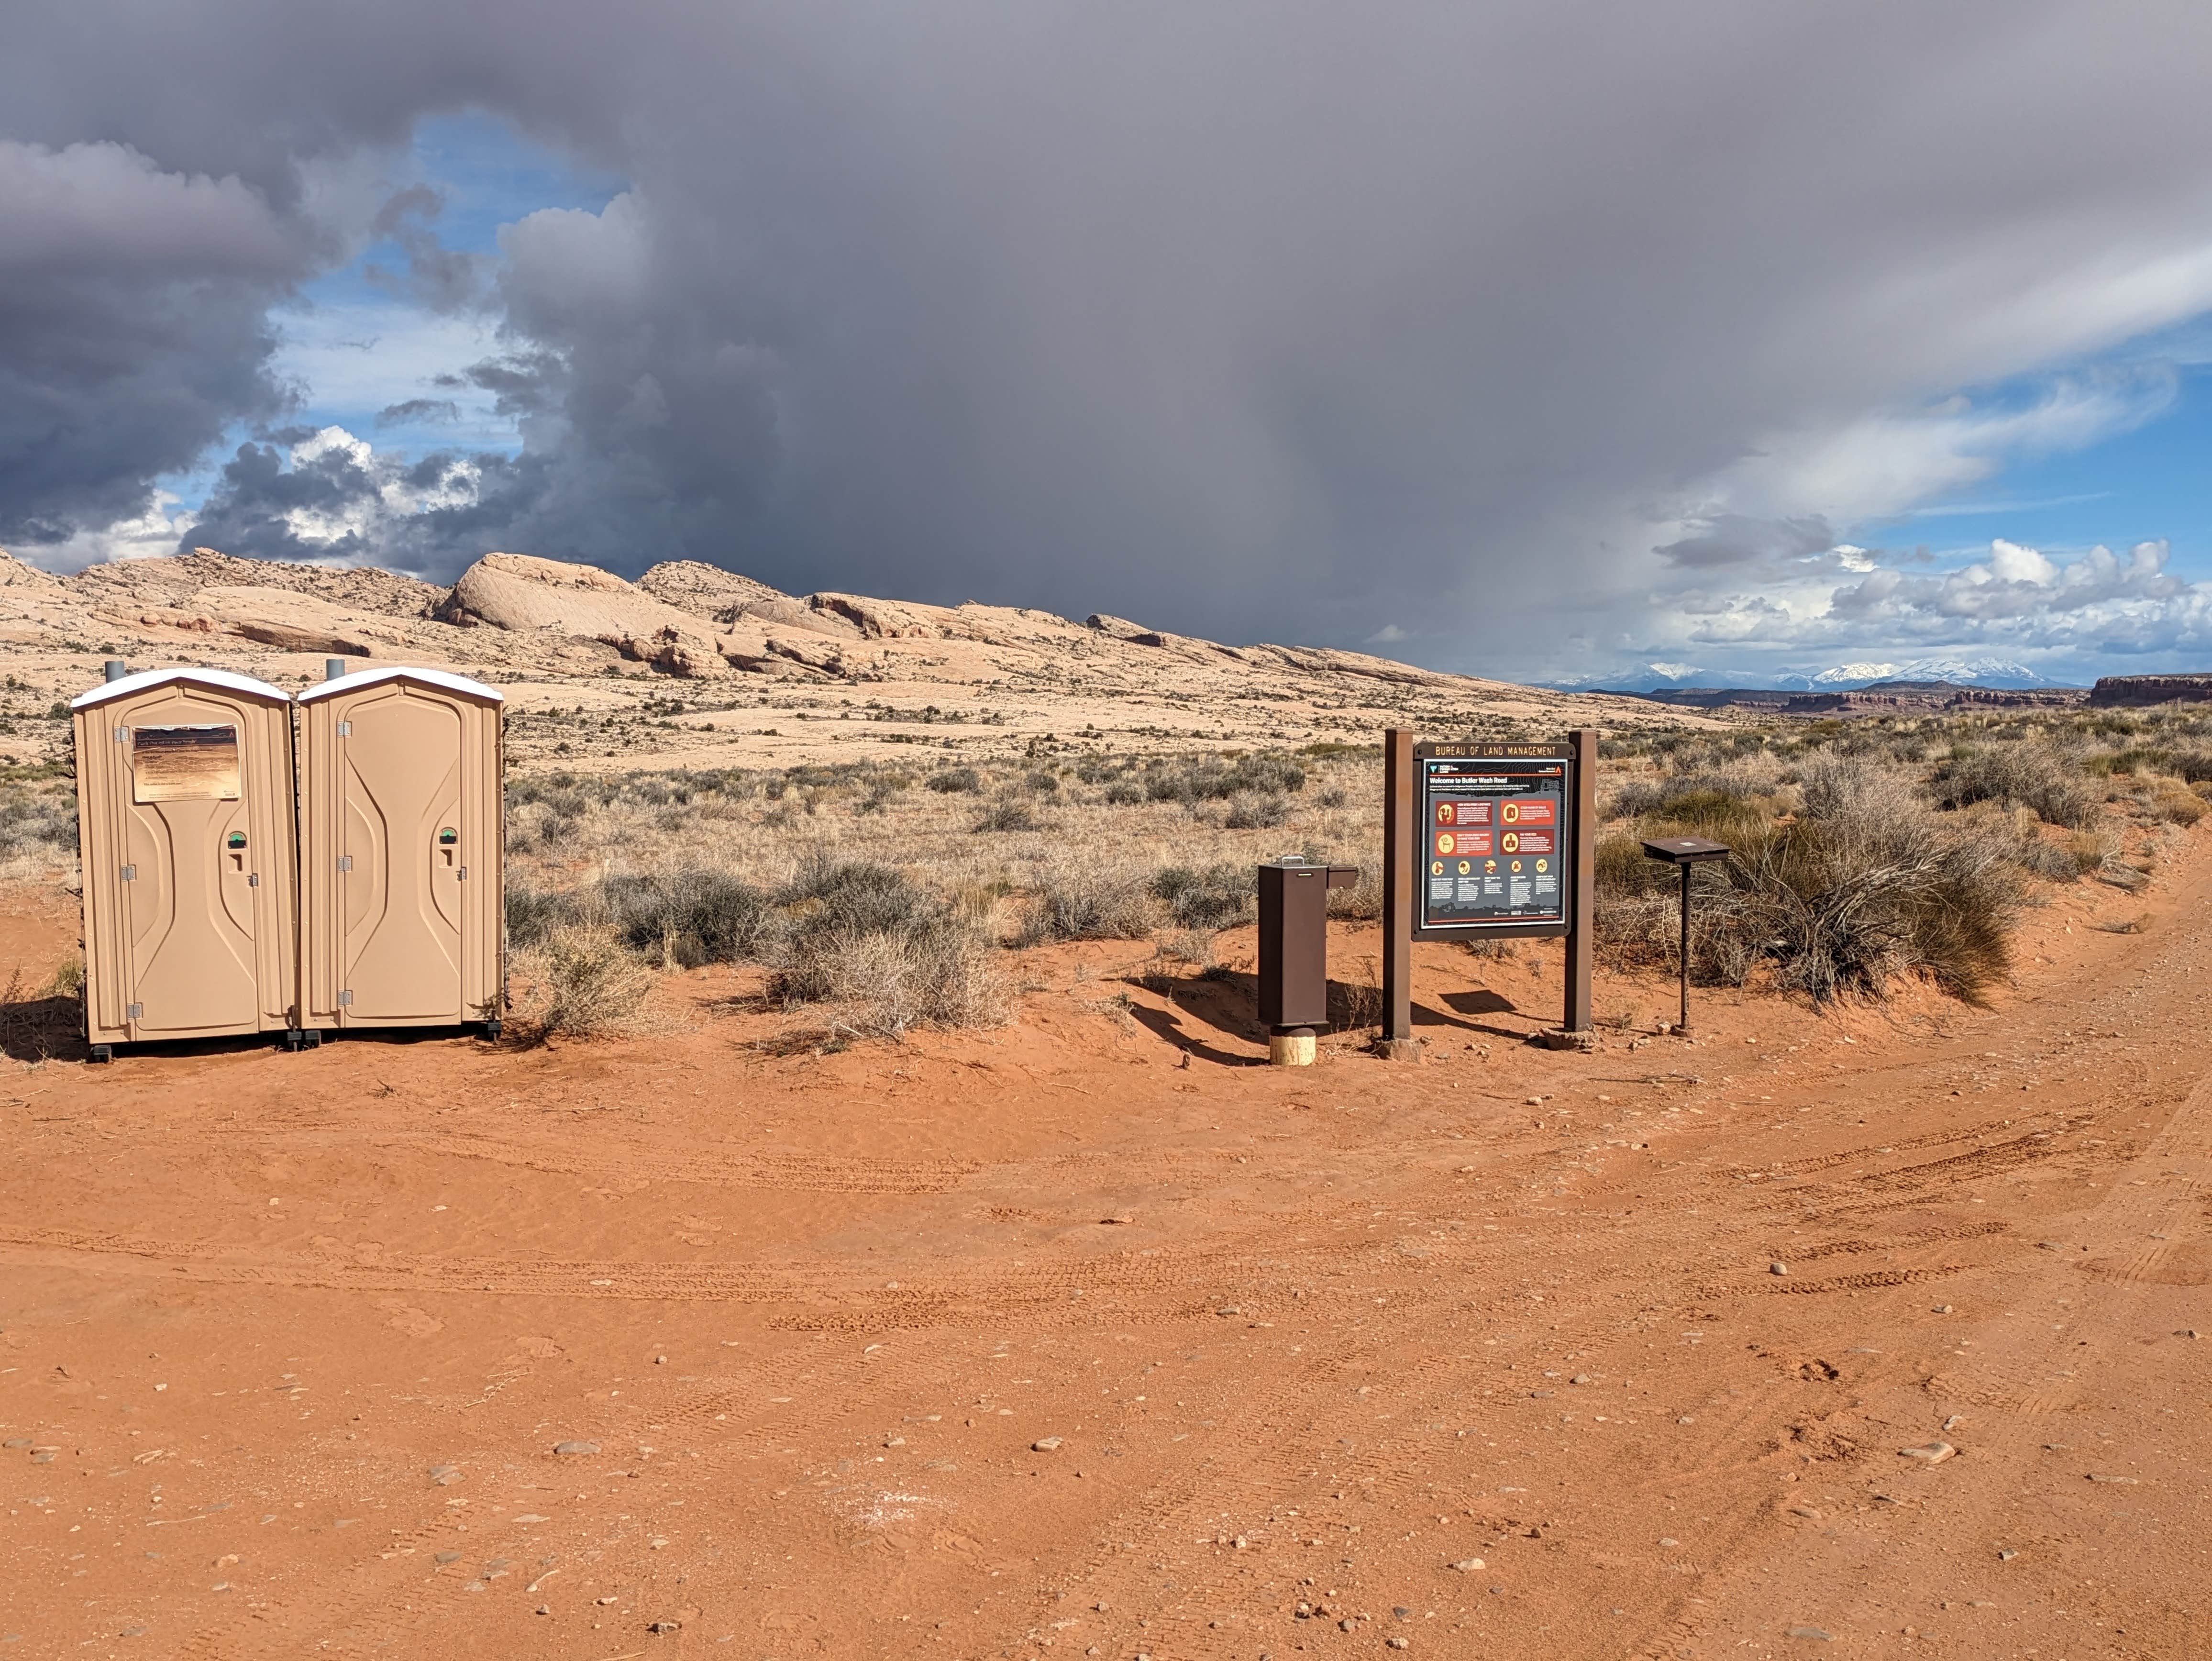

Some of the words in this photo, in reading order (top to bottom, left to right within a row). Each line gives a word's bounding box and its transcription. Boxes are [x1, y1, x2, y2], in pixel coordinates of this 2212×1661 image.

[1436, 746, 1465, 756] BUREAU
[1470, 746, 1479, 756] OF
[1484, 746, 1503, 756] LAND
[1507, 746, 1556, 756] MANAGEMENT
